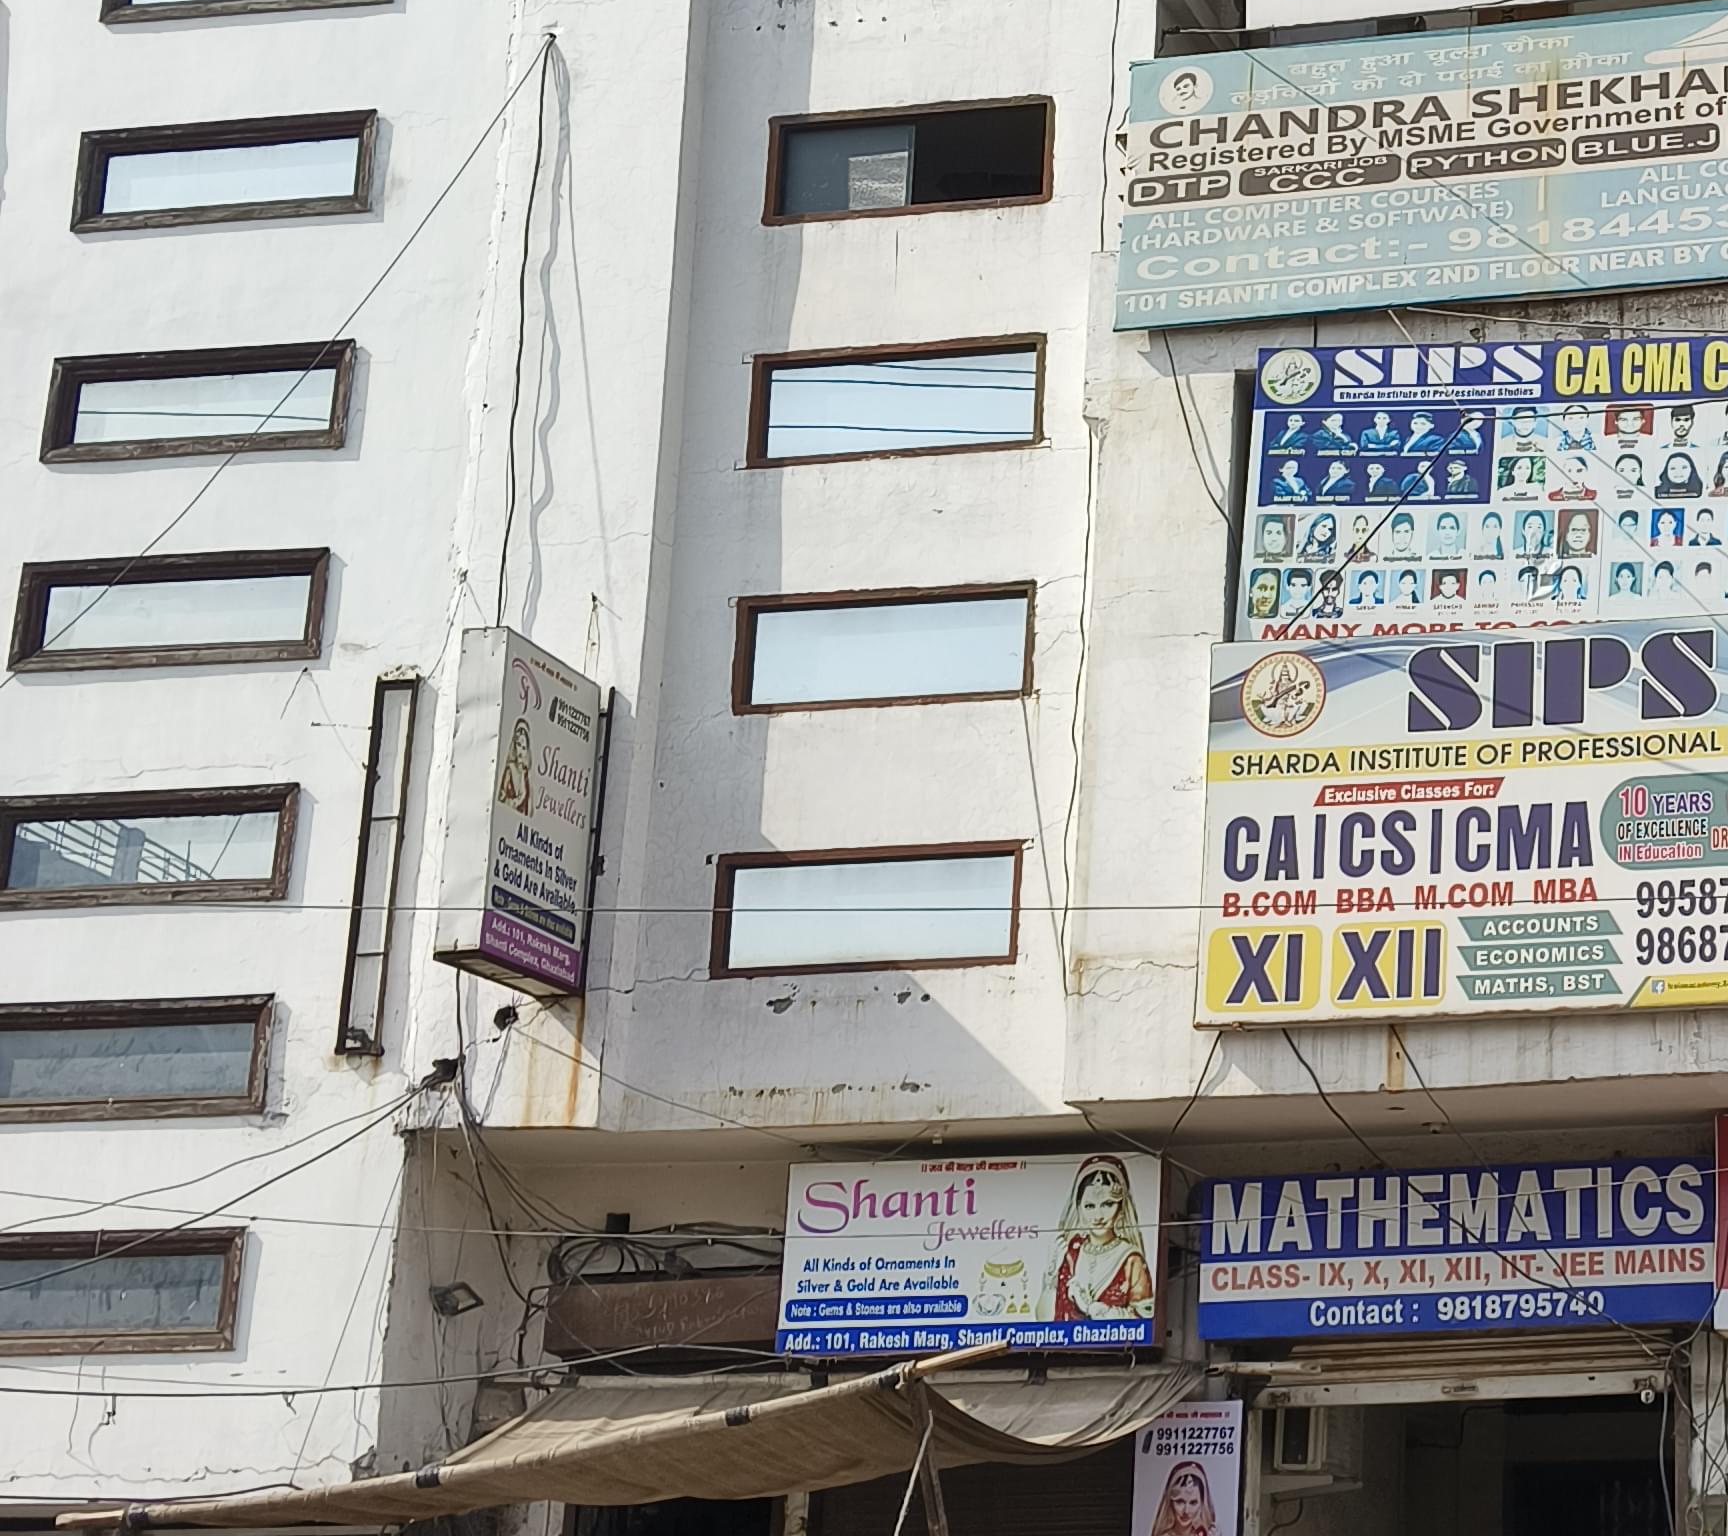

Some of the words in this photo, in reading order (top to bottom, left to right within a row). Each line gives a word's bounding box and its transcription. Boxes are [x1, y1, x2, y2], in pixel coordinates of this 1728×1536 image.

[1149, 96, 1453, 148] CHANDRA
[1149, 138, 1312, 171] Registered
[1328, 134, 1364, 157] By
[1379, 121, 1475, 149] MSME
[1488, 102, 1684, 137] Government
[1696, 94, 1727, 116] of
[1412, 143, 1564, 174] PYTHON
[1133, 176, 1227, 203] DTP
[1334, 345, 1543, 384] SIPS
[1554, 346, 1612, 396] CA
[1622, 343, 1691, 392] CMA
[1406, 629, 1721, 733] SIPS
[1232, 751, 1339, 777] SHARDA
[1350, 745, 1467, 772] INSTITUTE
[1476, 742, 1512, 764] OF
[1523, 732, 1723, 763] PROFESSIONAL
[538, 745, 592, 797] Shanti
[1323, 785, 1397, 804] Exclusive
[1399, 782, 1460, 800] Classes
[1465, 780, 1496, 798] For:
[1619, 786, 1649, 816] 10
[1652, 792, 1712, 814] YEARS
[1617, 823, 1633, 839] OF
[1636, 819, 1707, 838] EXCELLENCE
[1617, 845, 1633, 861] IN
[1636, 842, 1703, 859] Education
[1223, 889, 1317, 917] B.COM
[1336, 886, 1395, 913] BBA
[1415, 881, 1513, 909] M.COM
[1533, 878, 1598, 904] MBA
[1483, 916, 1599, 936] ACCOUNTS
[1225, 931, 1304, 1006] XI
[1336, 929, 1443, 1003] XII
[1475, 944, 1605, 966] ECONOMICS
[1474, 976, 1553, 997] MATHS,
[1561, 973, 1605, 993] BST
[798, 1177, 977, 1234] Shanti
[1211, 1163, 1705, 1255] MATHEMATICS
[923, 1219, 1039, 1252] Jewellers
[803, 1259, 820, 1273] All
[823, 1257, 856, 1273] Kinds
[859, 1256, 872, 1271] of
[875, 1256, 941, 1273] Ornaments
[944, 1256, 956, 1270] In
[1319, 1262, 1354, 1290] IX,
[1363, 1262, 1389, 1288] X,
[1400, 1259, 1434, 1287] XI,
[1445, 1256, 1490, 1286] XII,
[1552, 1251, 1604, 1278] JEE
[1614, 1247, 1706, 1275] MAINS
[796, 1279, 830, 1295] Silver
[834, 1280, 843, 1292] &
[845, 1278, 875, 1293] Gold
[879, 1278, 901, 1292] Are
[903, 1275, 959, 1291] Available
[1309, 1298, 1404, 1327] Contact
[1438, 1290, 1604, 1322] 9818795740
[825, 1331, 856, 1350] 101,
[860, 1330, 909, 1349] Rakesh
[913, 1329, 954, 1351] Marg,
[958, 1327, 1005, 1346] Shanti
[1073, 1324, 1145, 1343] Ghaziabad
[1156, 1442, 1234, 1456] 9911227756
[1157, 1427, 1234, 1440] 9911227767
